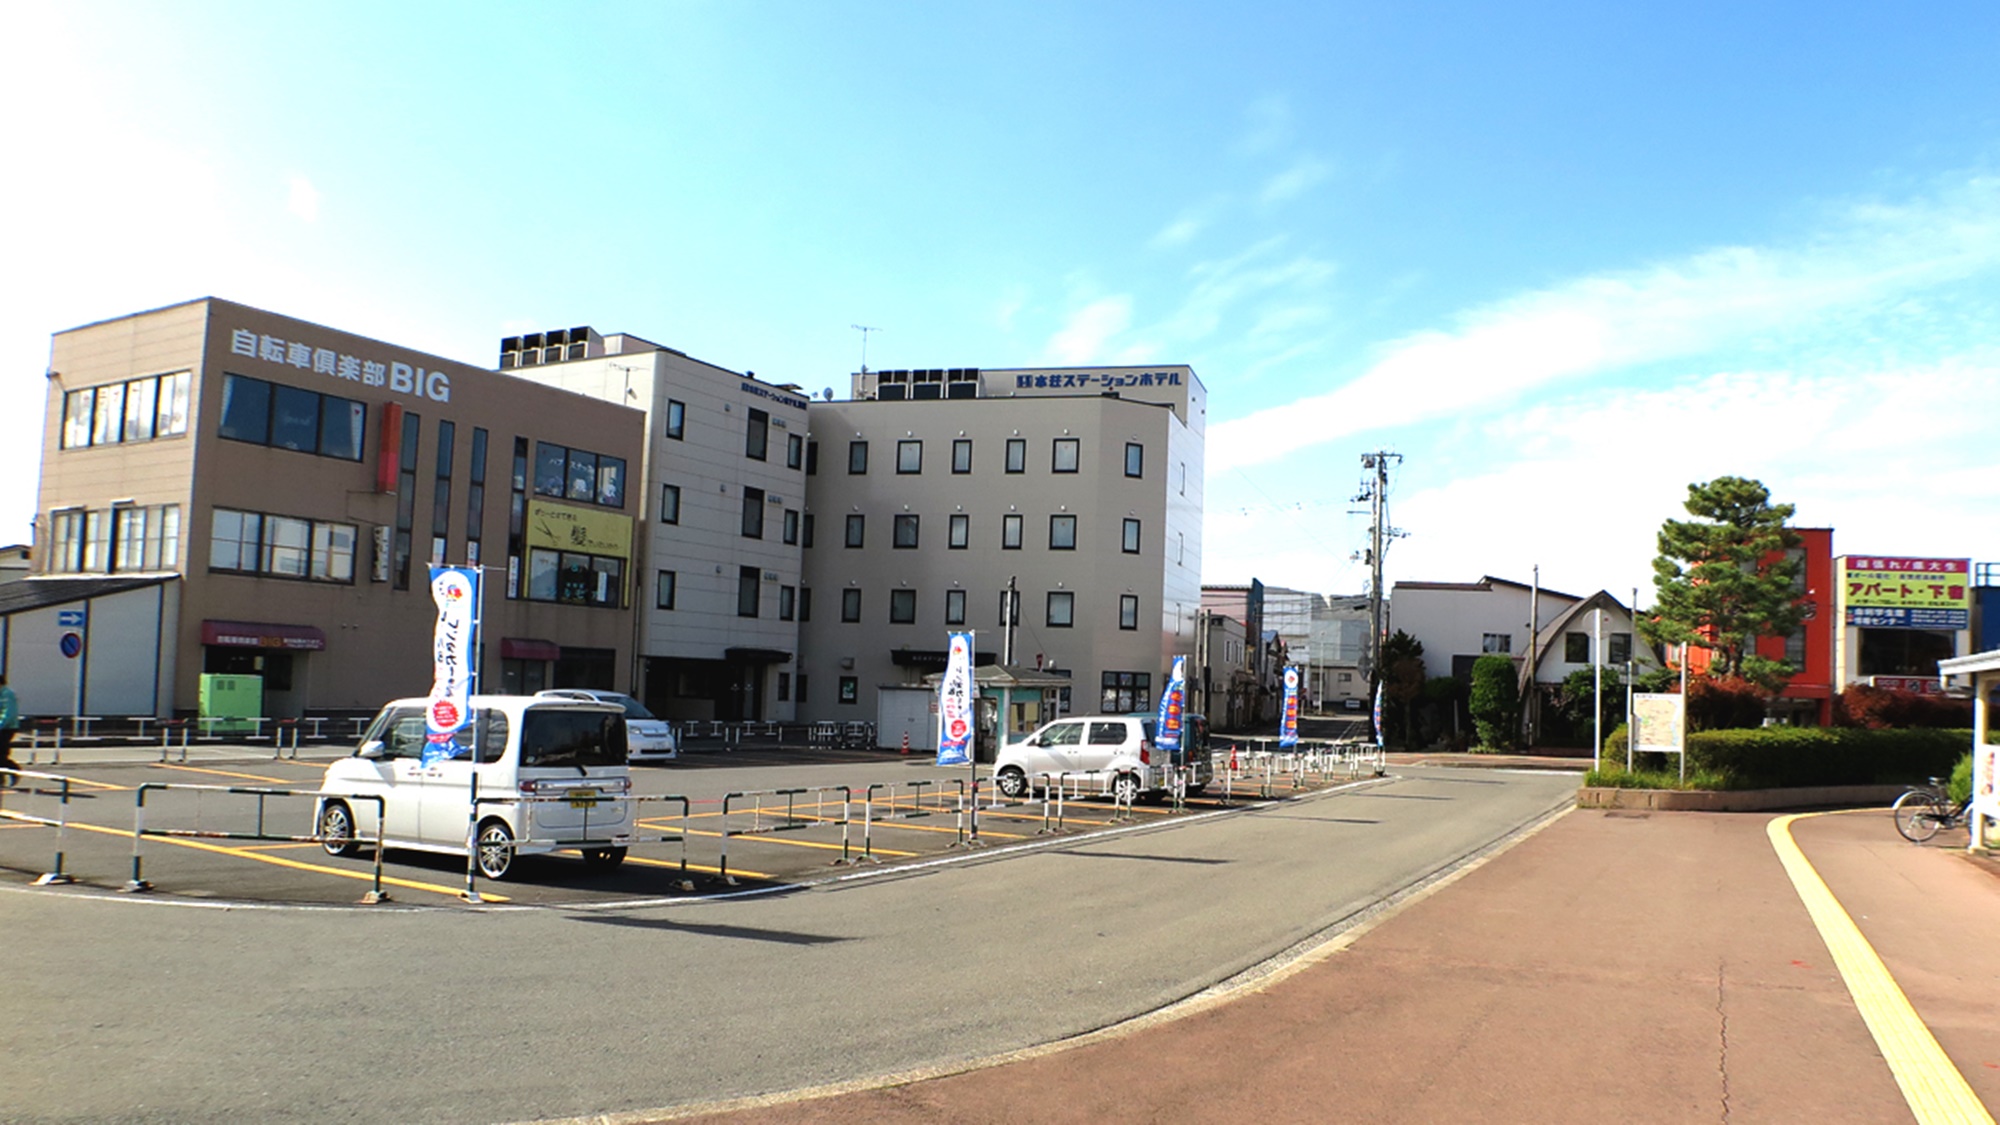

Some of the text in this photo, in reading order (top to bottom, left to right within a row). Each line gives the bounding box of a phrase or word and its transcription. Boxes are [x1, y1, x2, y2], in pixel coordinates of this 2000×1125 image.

[231, 329, 451, 403] 自転車倶楽部 BIG
[1034, 372, 1182, 388] 本荘ステーションホテル
